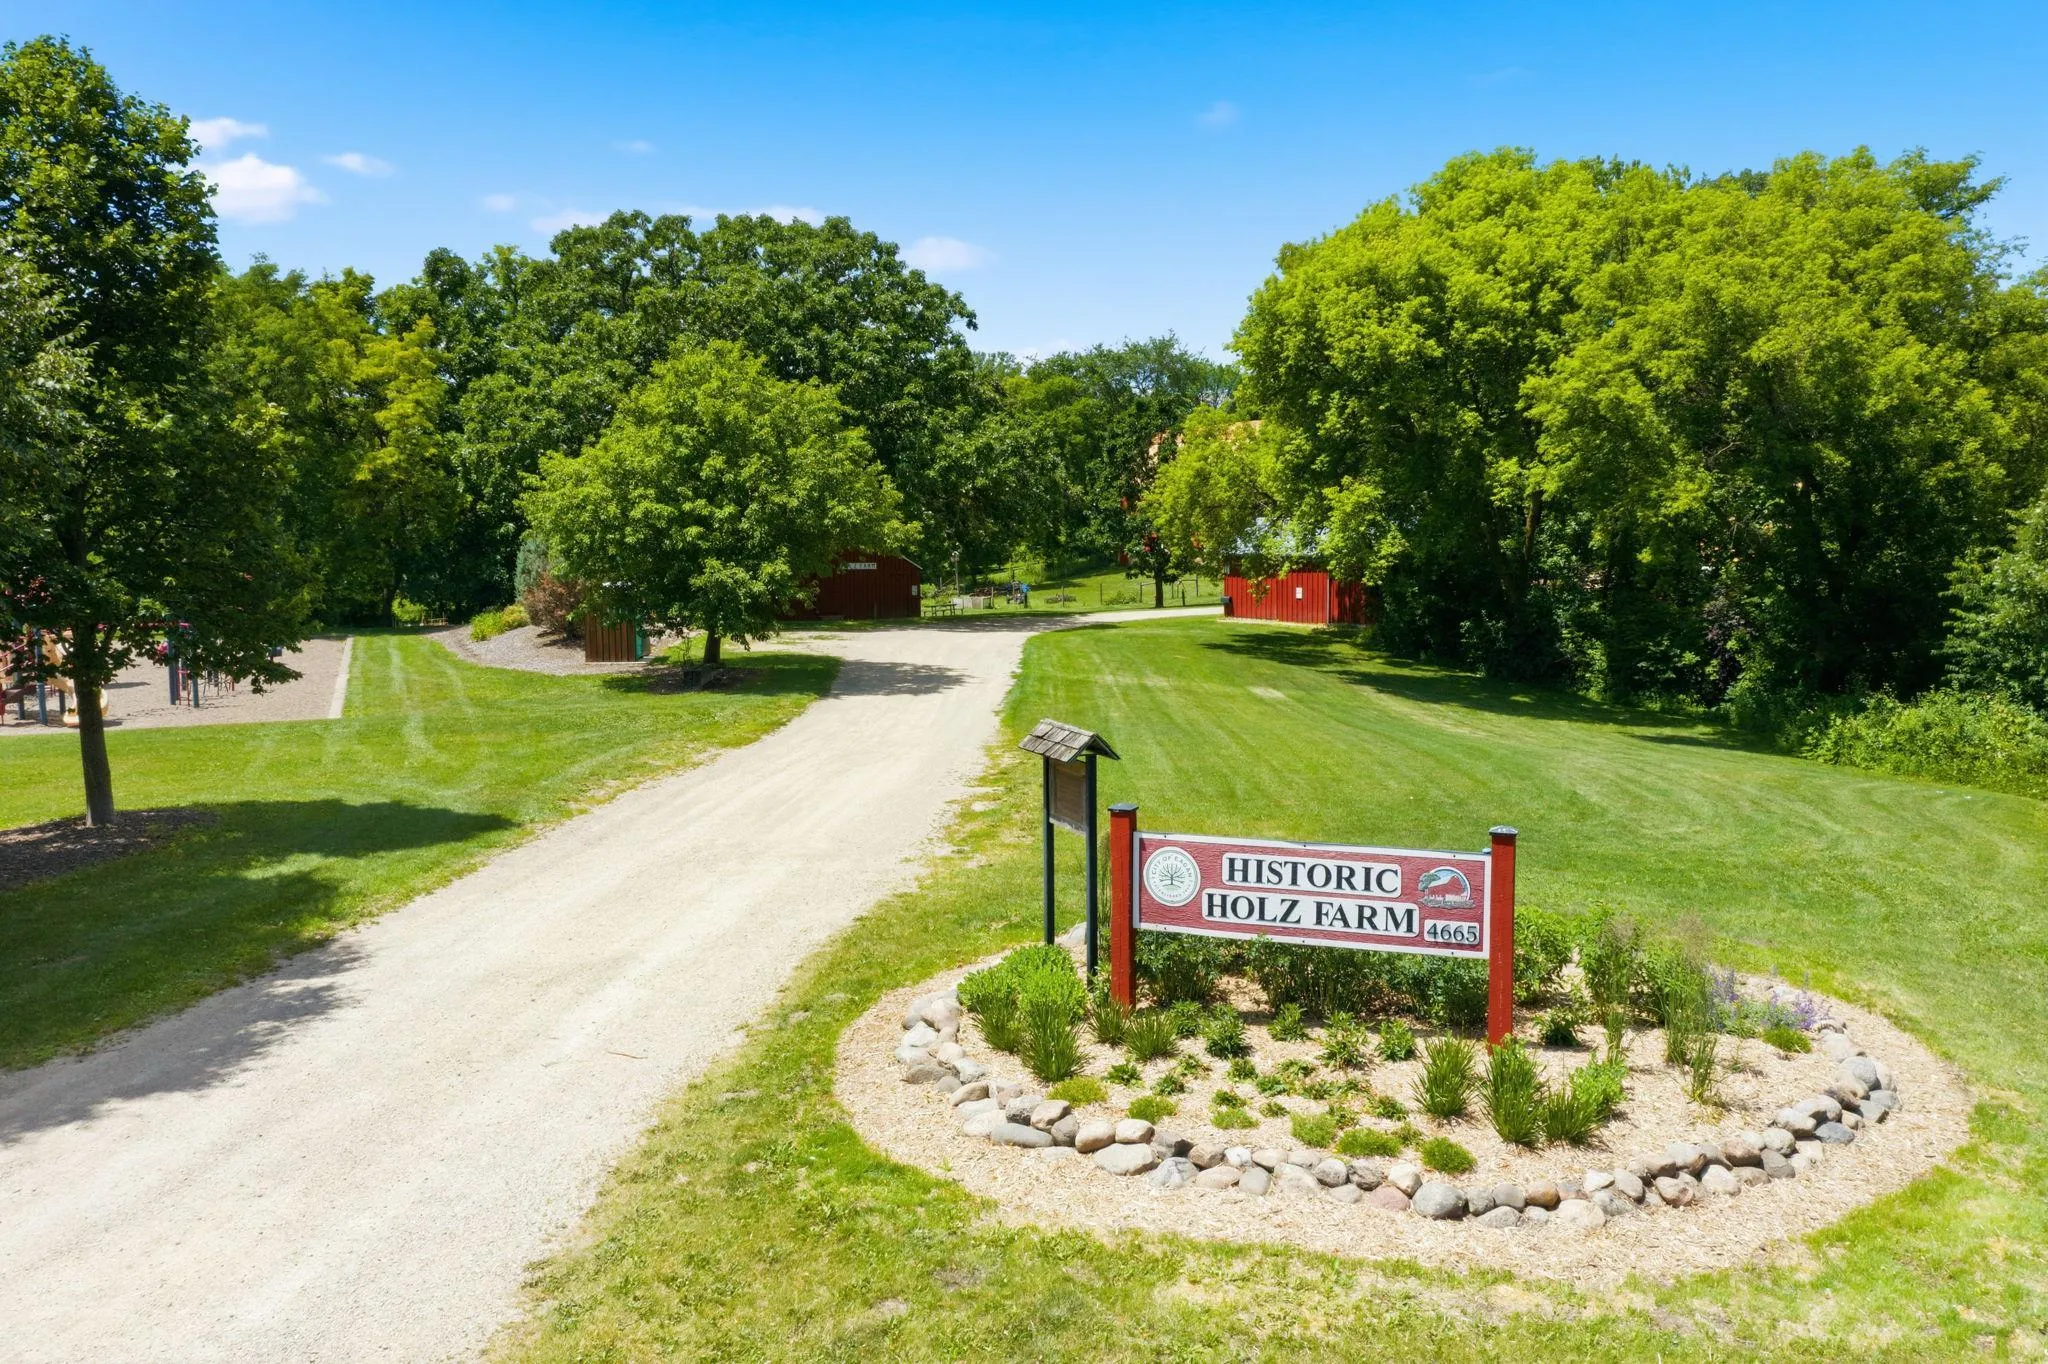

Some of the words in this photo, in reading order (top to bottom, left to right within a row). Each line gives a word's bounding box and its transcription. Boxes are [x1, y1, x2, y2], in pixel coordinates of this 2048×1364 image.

[1174, 855, 1192, 878] EAGAN
[1226, 857, 1399, 894] HISTORIC
[1204, 892, 1302, 925] HOLZ
[1313, 900, 1417, 934] FARM
[1427, 922, 1477, 943] 4665
